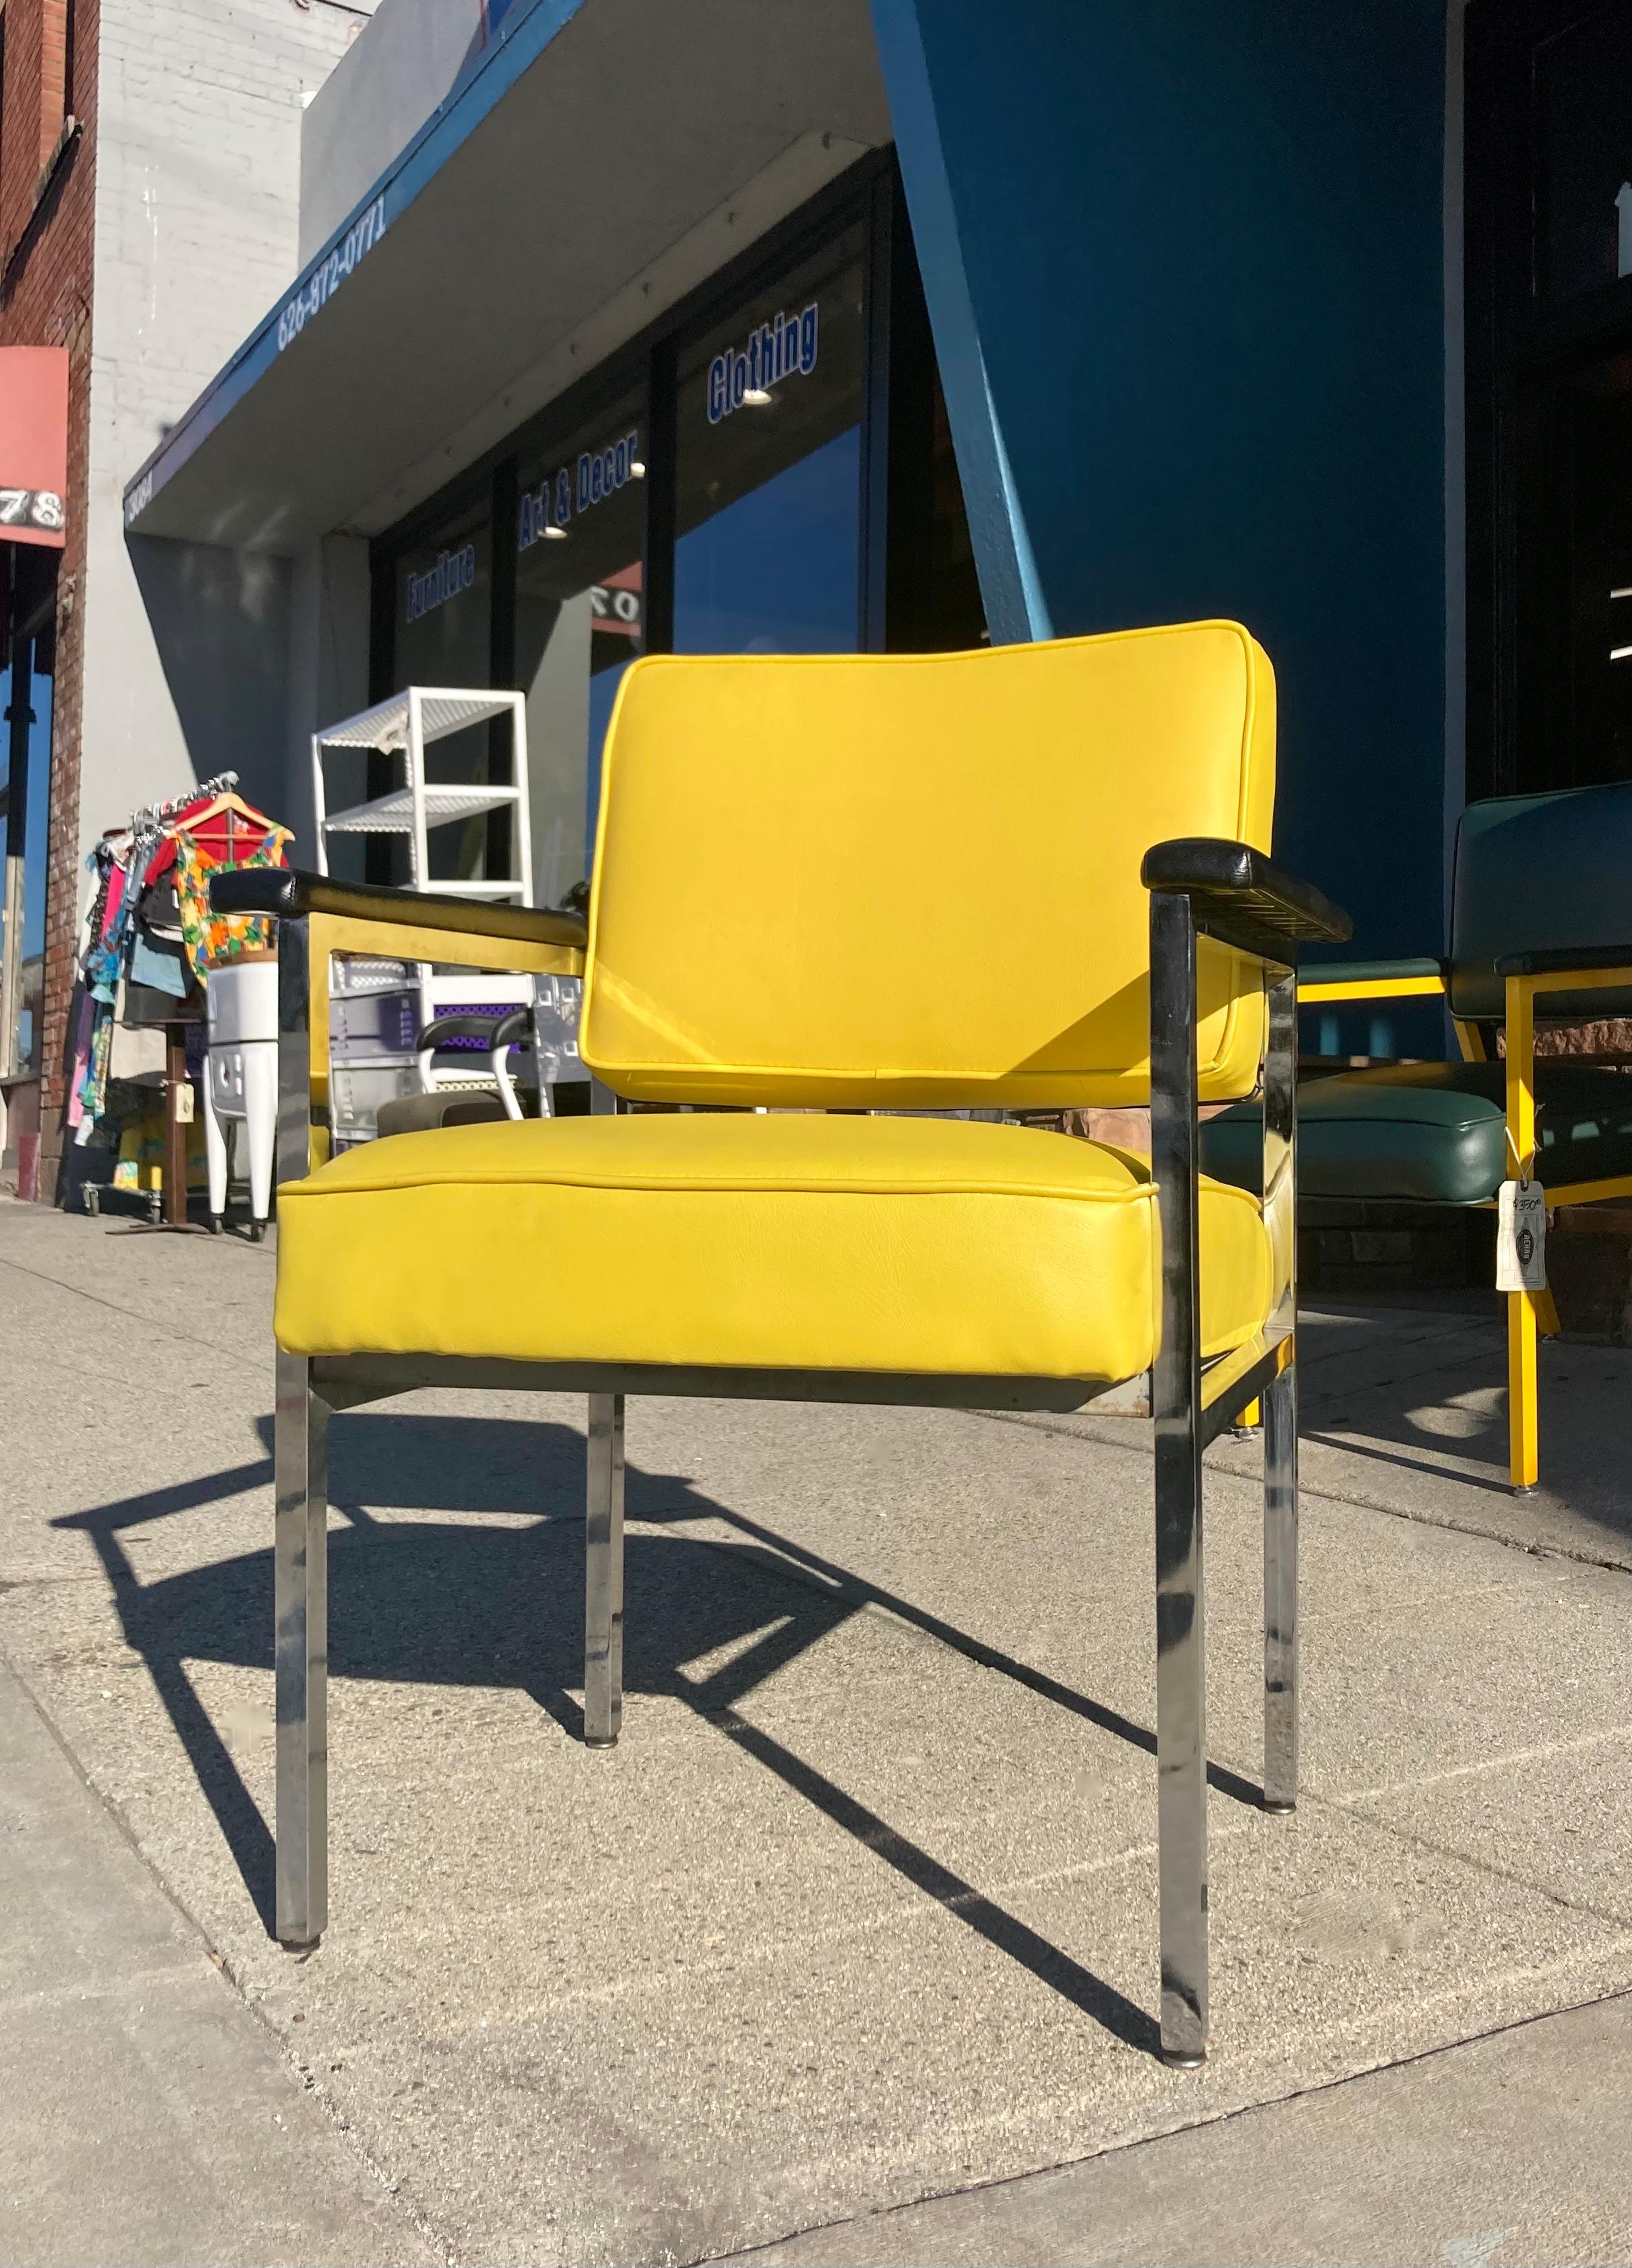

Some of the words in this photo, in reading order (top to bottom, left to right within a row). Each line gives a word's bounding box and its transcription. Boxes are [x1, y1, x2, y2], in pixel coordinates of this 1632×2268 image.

[707, 301, 819, 424] Clothing
[517, 480, 551, 552] Art
[554, 467, 571, 526] &
[576, 428, 639, 514] Decor
[405, 543, 475, 624] Furniture
